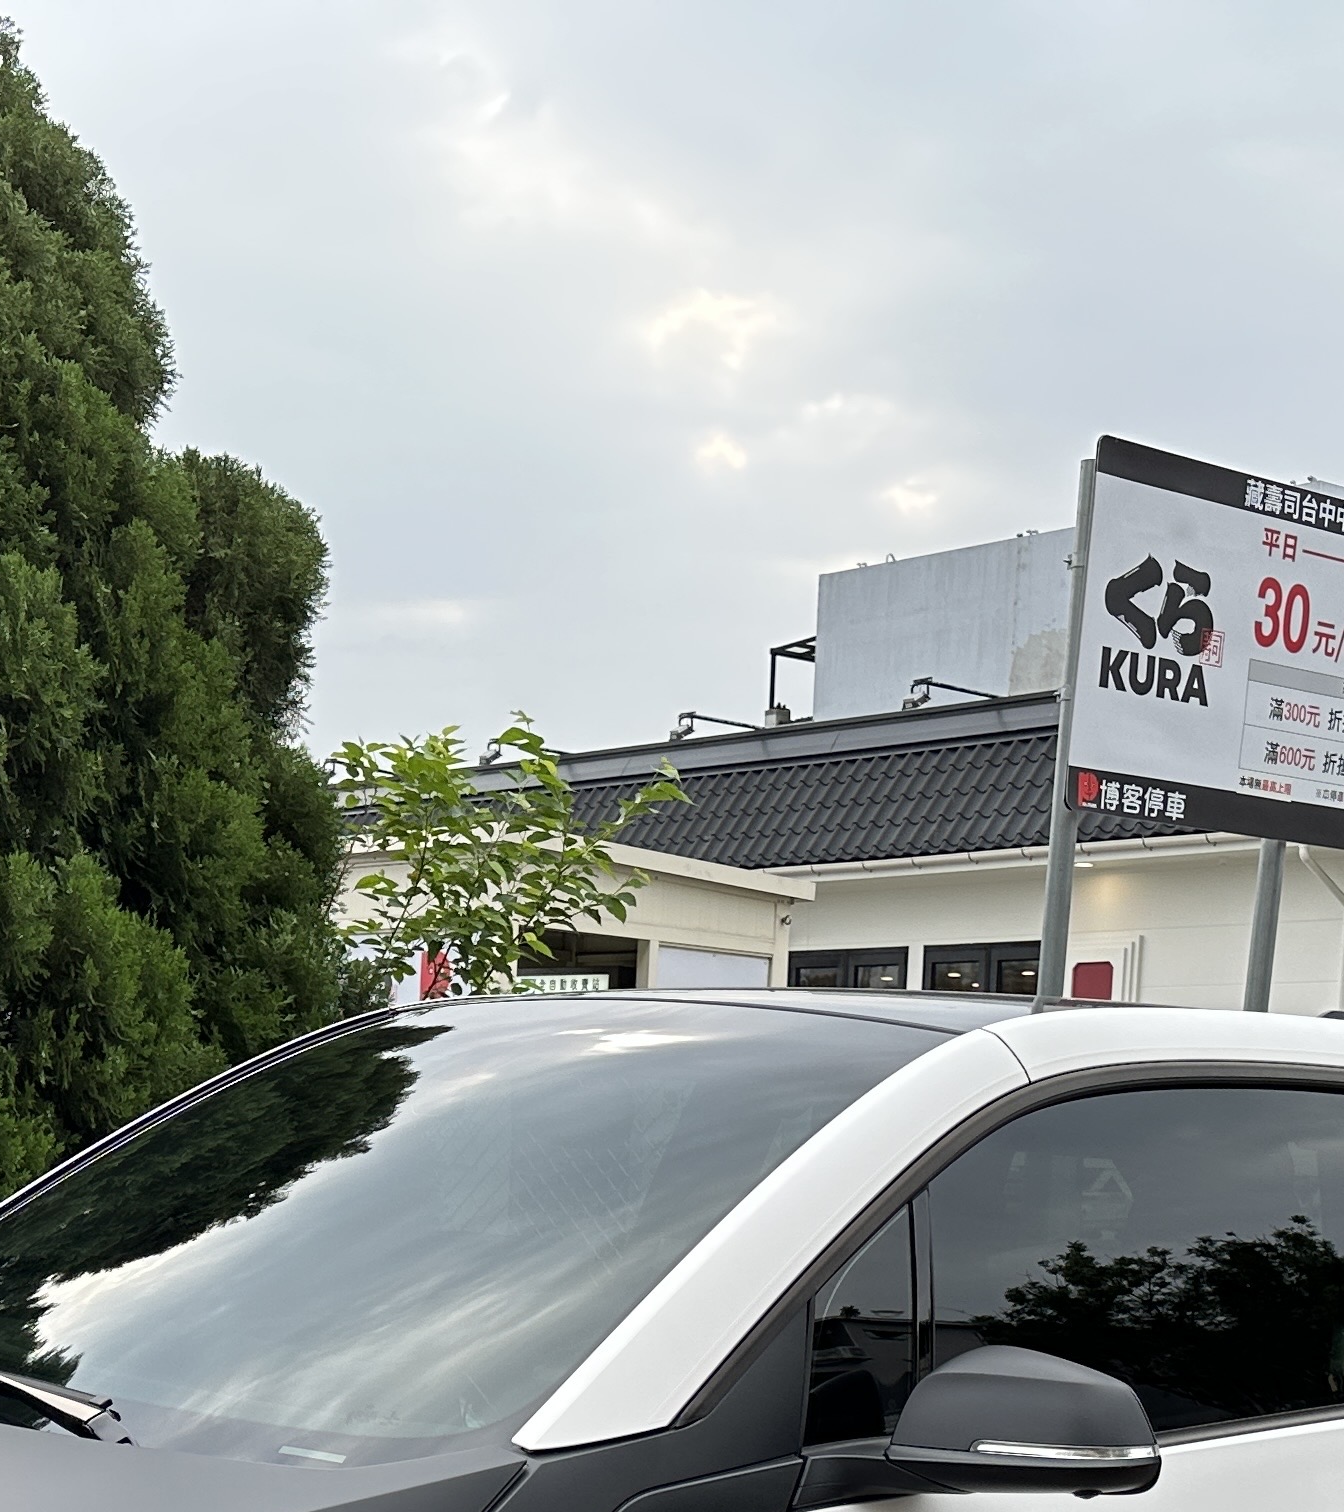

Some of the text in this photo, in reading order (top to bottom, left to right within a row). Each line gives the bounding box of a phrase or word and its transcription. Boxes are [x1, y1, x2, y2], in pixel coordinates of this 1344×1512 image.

[1262, 528, 1298, 562] 平日
[1098, 646, 1208, 708] KURA
[1268, 696, 1321, 728] 滿300元
[1263, 740, 1316, 771] 滿600元
[1099, 779, 1187, 822] 博客停車
